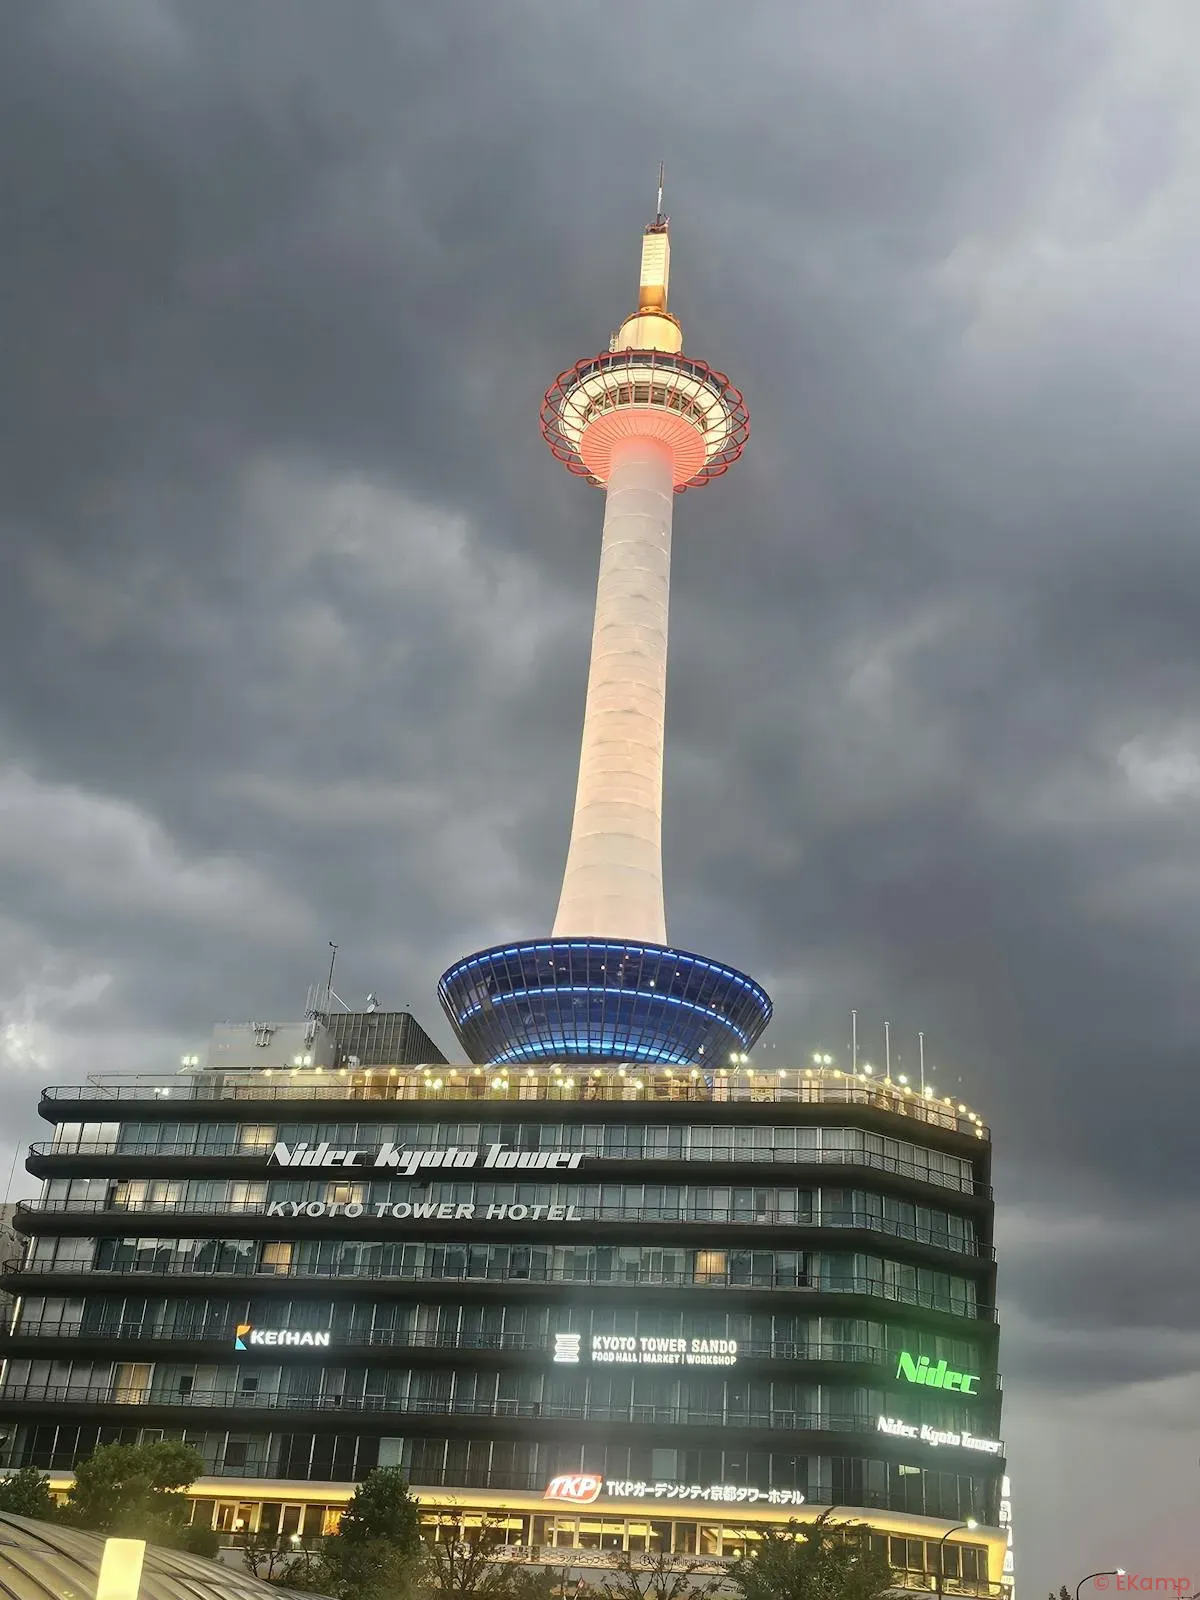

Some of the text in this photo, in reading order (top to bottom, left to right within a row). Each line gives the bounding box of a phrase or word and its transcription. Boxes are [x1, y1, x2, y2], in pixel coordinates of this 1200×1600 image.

[266, 1142, 587, 1175] Nidec Kyoto Tower
[266, 1201, 582, 1221] KYOTO TOWER HOTEL
[250, 1329, 330, 1346] KEIHAN
[592, 1336, 737, 1354] KYOTO TOWER SANDO
[592, 1351, 736, 1365] FOOD HALL MARKET WORKSHOP
[896, 1352, 980, 1395] Nidec
[877, 1416, 1001, 1453] Nidec Kyoto Tower
[550, 1477, 597, 1497] TKP
[606, 1480, 805, 1504] TKPガーデンシティ京都タワーホテル
